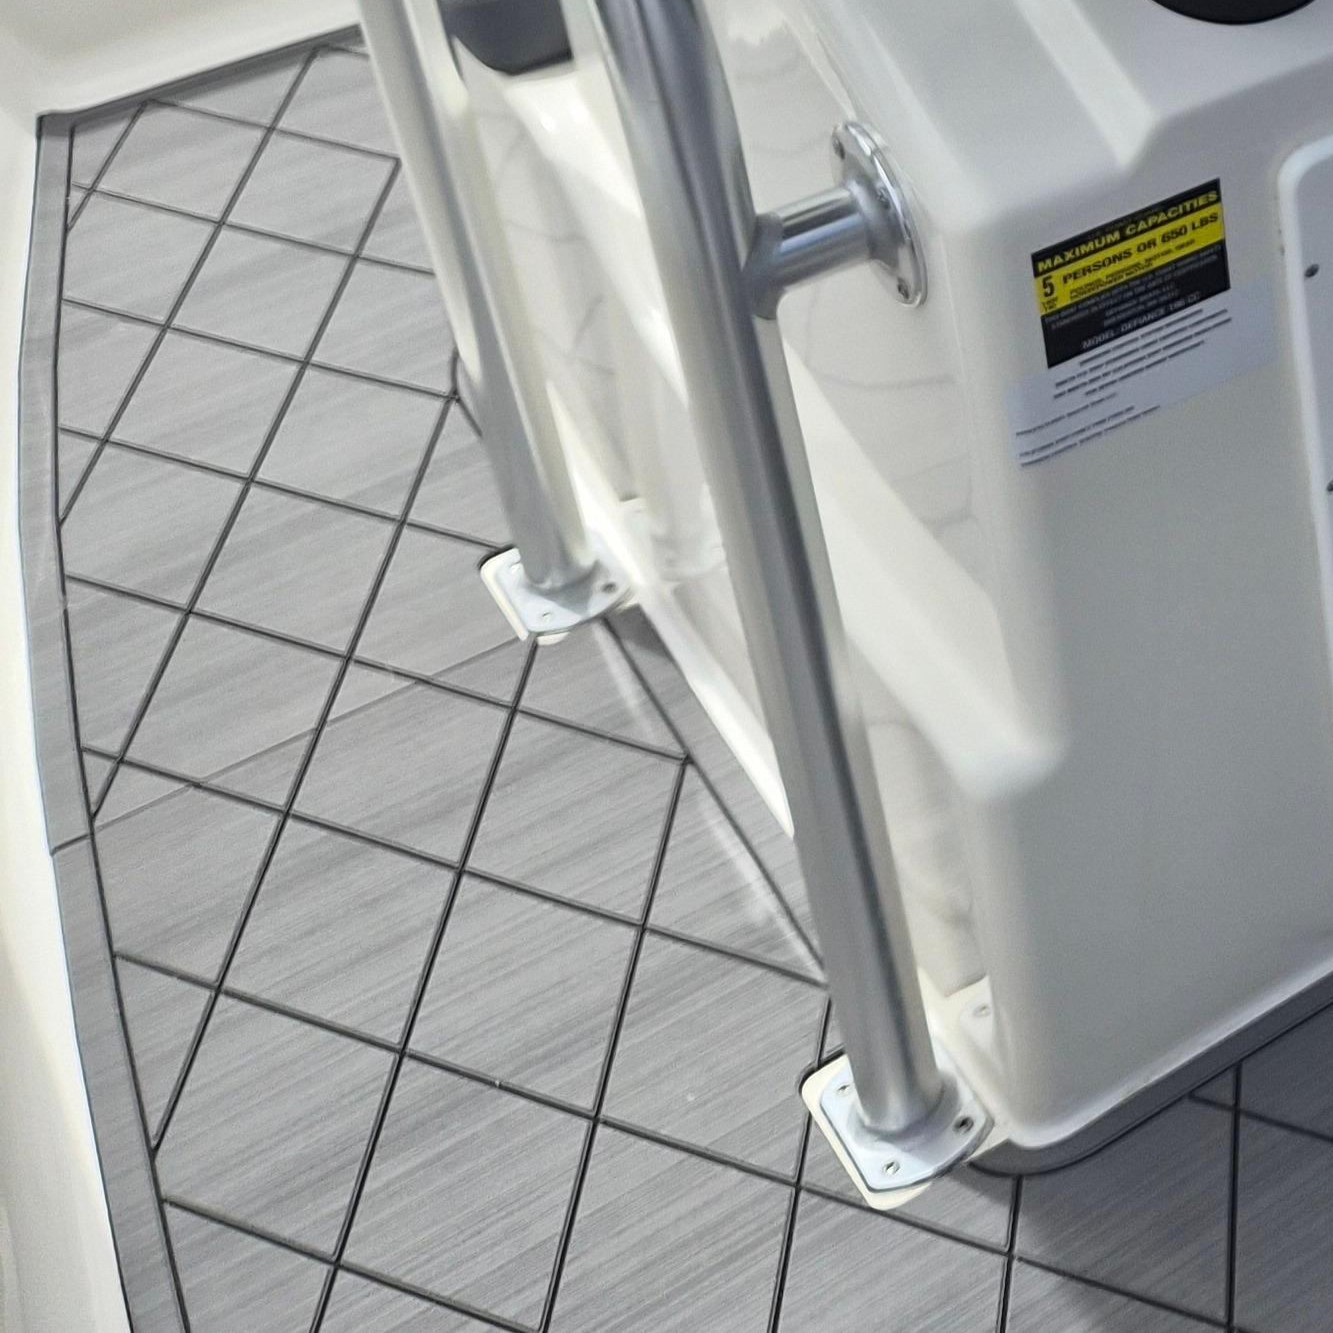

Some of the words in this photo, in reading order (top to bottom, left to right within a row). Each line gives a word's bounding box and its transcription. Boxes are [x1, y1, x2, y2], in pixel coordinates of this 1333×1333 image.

[1037, 230, 1121, 272] MAXIMUM
[1125, 191, 1218, 236] CAPACITIES
[1042, 275, 1055, 298] 5
[1062, 248, 1133, 284] PERSONS
[1136, 238, 1157, 252] OR
[1191, 212, 1219, 231] LBS
